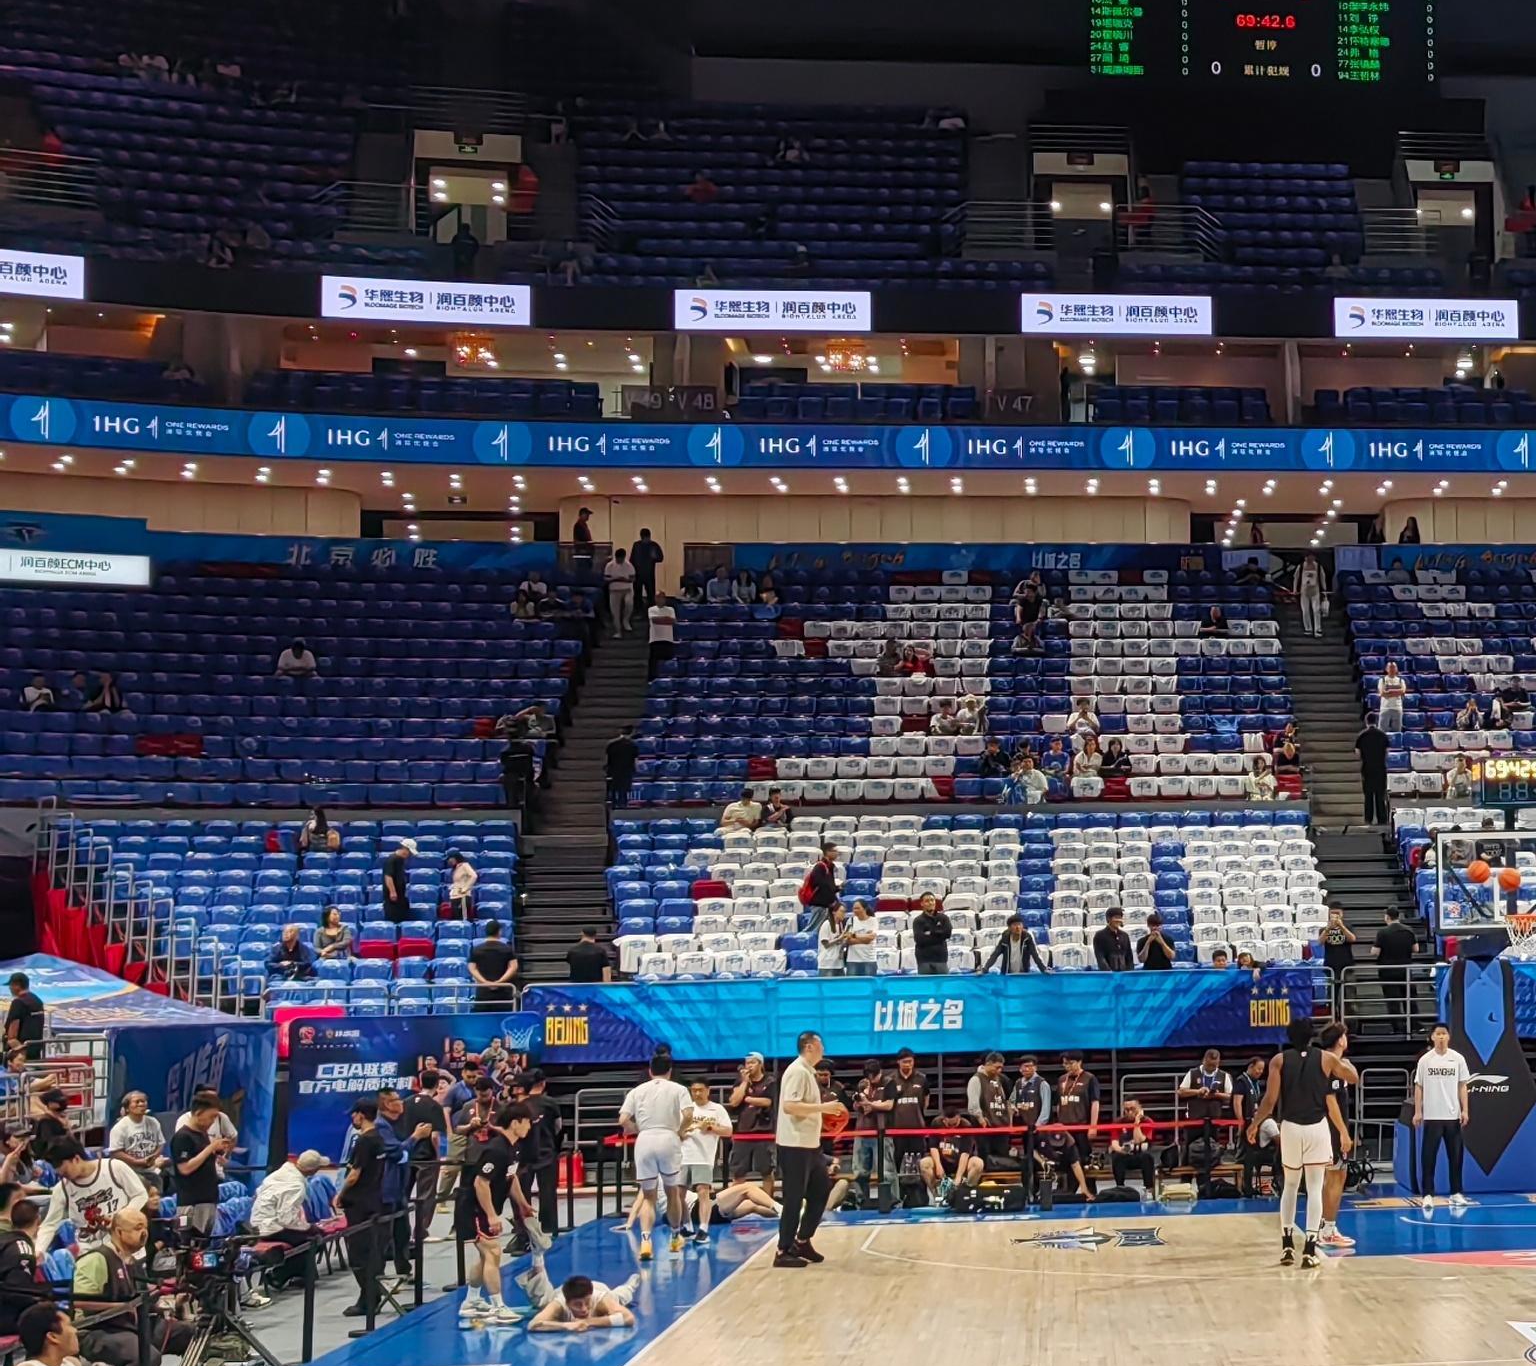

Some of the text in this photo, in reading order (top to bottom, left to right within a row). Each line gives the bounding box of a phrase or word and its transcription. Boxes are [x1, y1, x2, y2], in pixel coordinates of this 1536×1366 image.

[1236, 14, 1296, 29] 69:42.6
[1211, 61, 1221, 75] 0
[1310, 64, 1321, 77] 0
[93, 416, 139, 434] IHG
[328, 429, 370, 446] IHG
[549, 436, 589, 452] IHG
[760, 437, 800, 453] IHG
[969, 439, 1006, 454] IHG
[1171, 440, 1209, 456] IHG
[1369, 442, 1407, 457] IHG
[20, 556, 111, 571] 润百颜ECM中心
[874, 998, 964, 1032] 以城之名
[1250, 999, 1290, 1027] BEIJING
[545, 1016, 588, 1045] BEIJING
[316, 1061, 398, 1079] CBA联赛
[299, 1076, 413, 1095] 官方电解质饮料
[1467, 1084, 1509, 1093] I-NING
